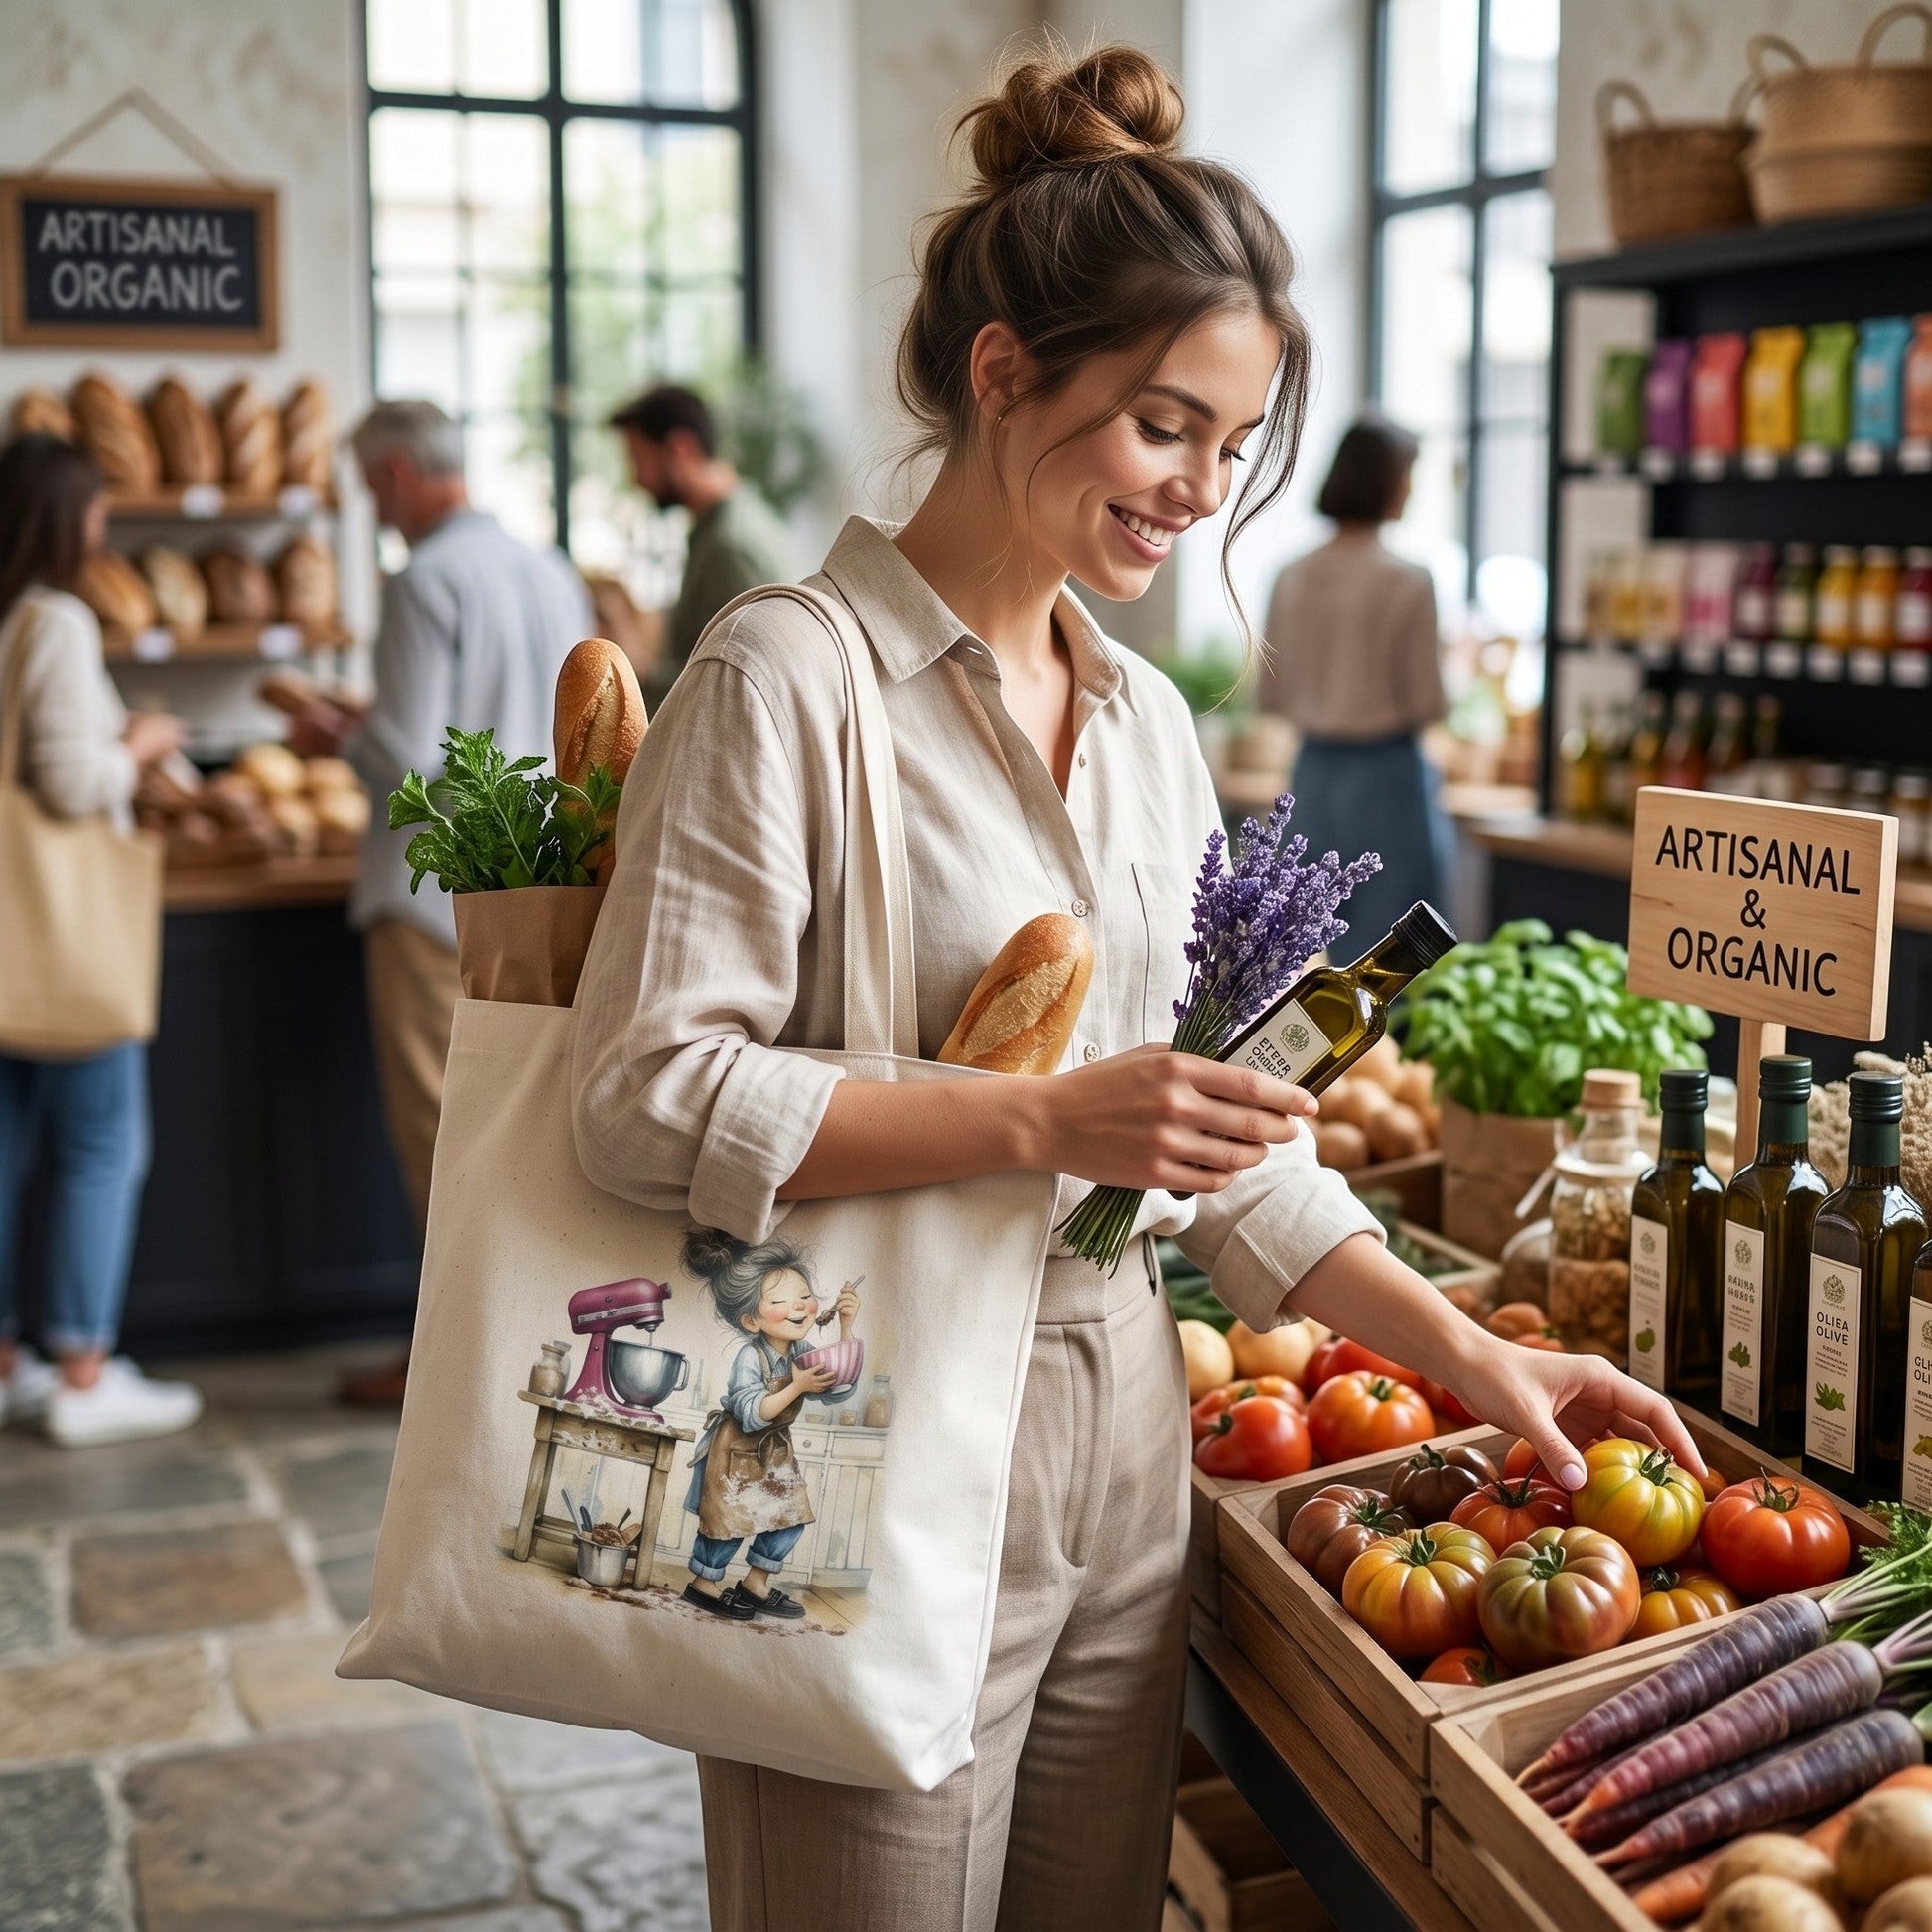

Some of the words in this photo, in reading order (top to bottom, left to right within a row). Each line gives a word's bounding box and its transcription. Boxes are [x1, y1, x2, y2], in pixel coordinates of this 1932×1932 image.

[39, 211, 234, 256] ARTISANAL
[51, 261, 242, 311] ORGANIC
[1654, 824, 1861, 896] ARTISANAL
[1739, 888, 1767, 930] &
[1667, 926, 1838, 997] ORGANIC
[1816, 1311, 1849, 1332] OLIEA
[1816, 1325, 1849, 1346] OLIVE
